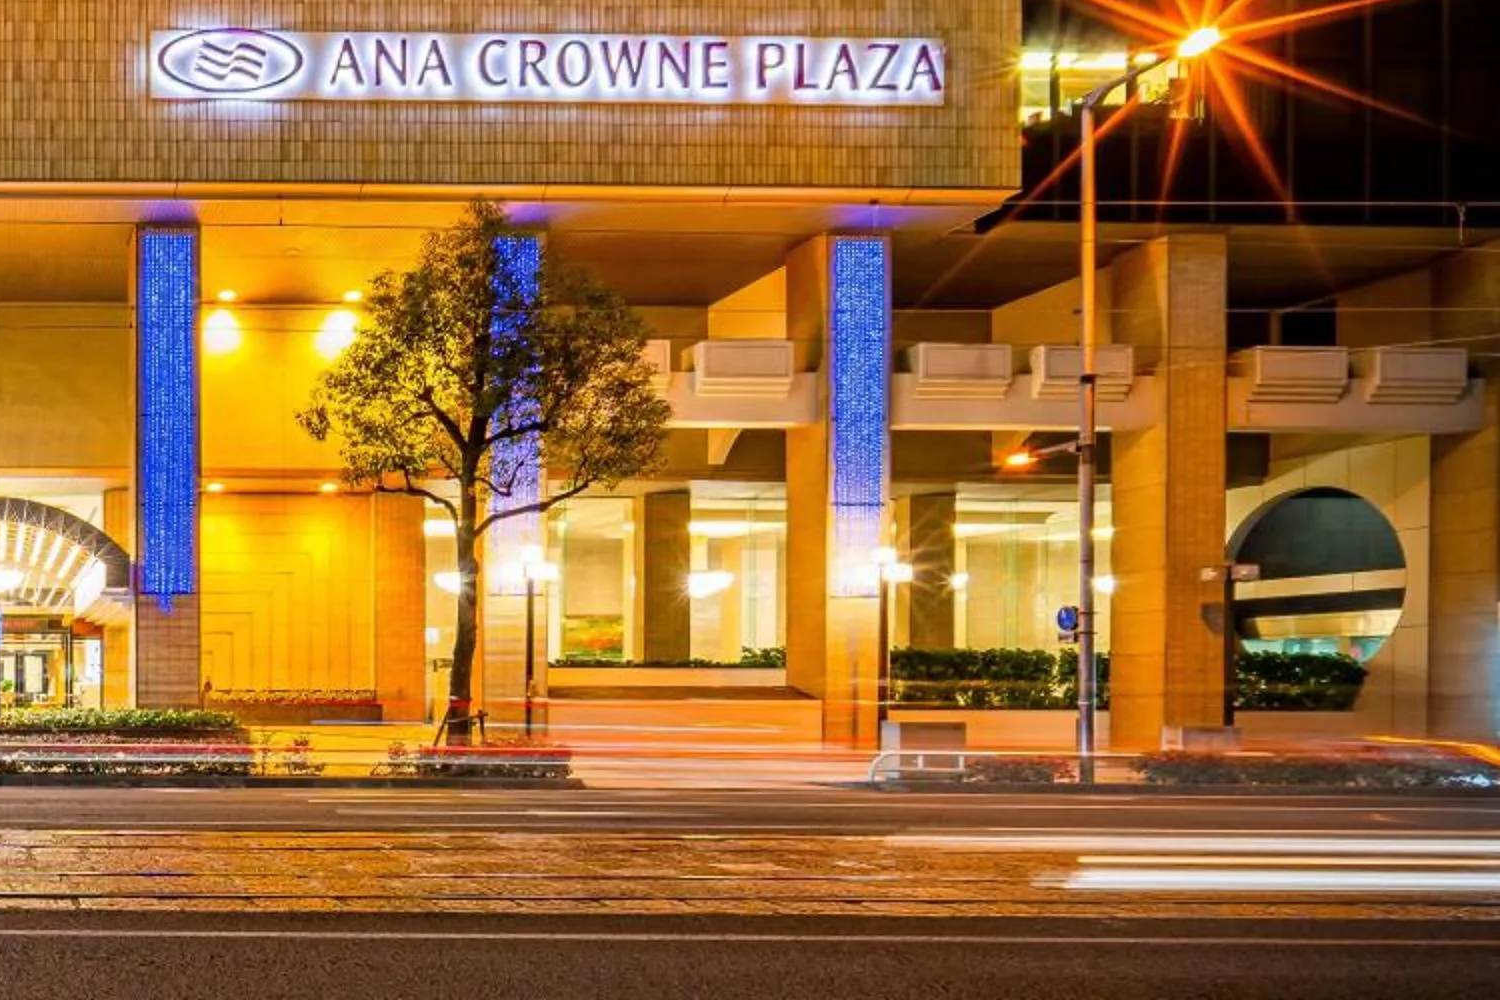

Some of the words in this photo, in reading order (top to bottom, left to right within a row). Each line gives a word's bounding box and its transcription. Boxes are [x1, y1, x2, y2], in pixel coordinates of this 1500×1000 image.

[329, 37, 453, 87] ANA
[477, 38, 729, 89] CROWNE
[756, 42, 943, 91] PLAZA
